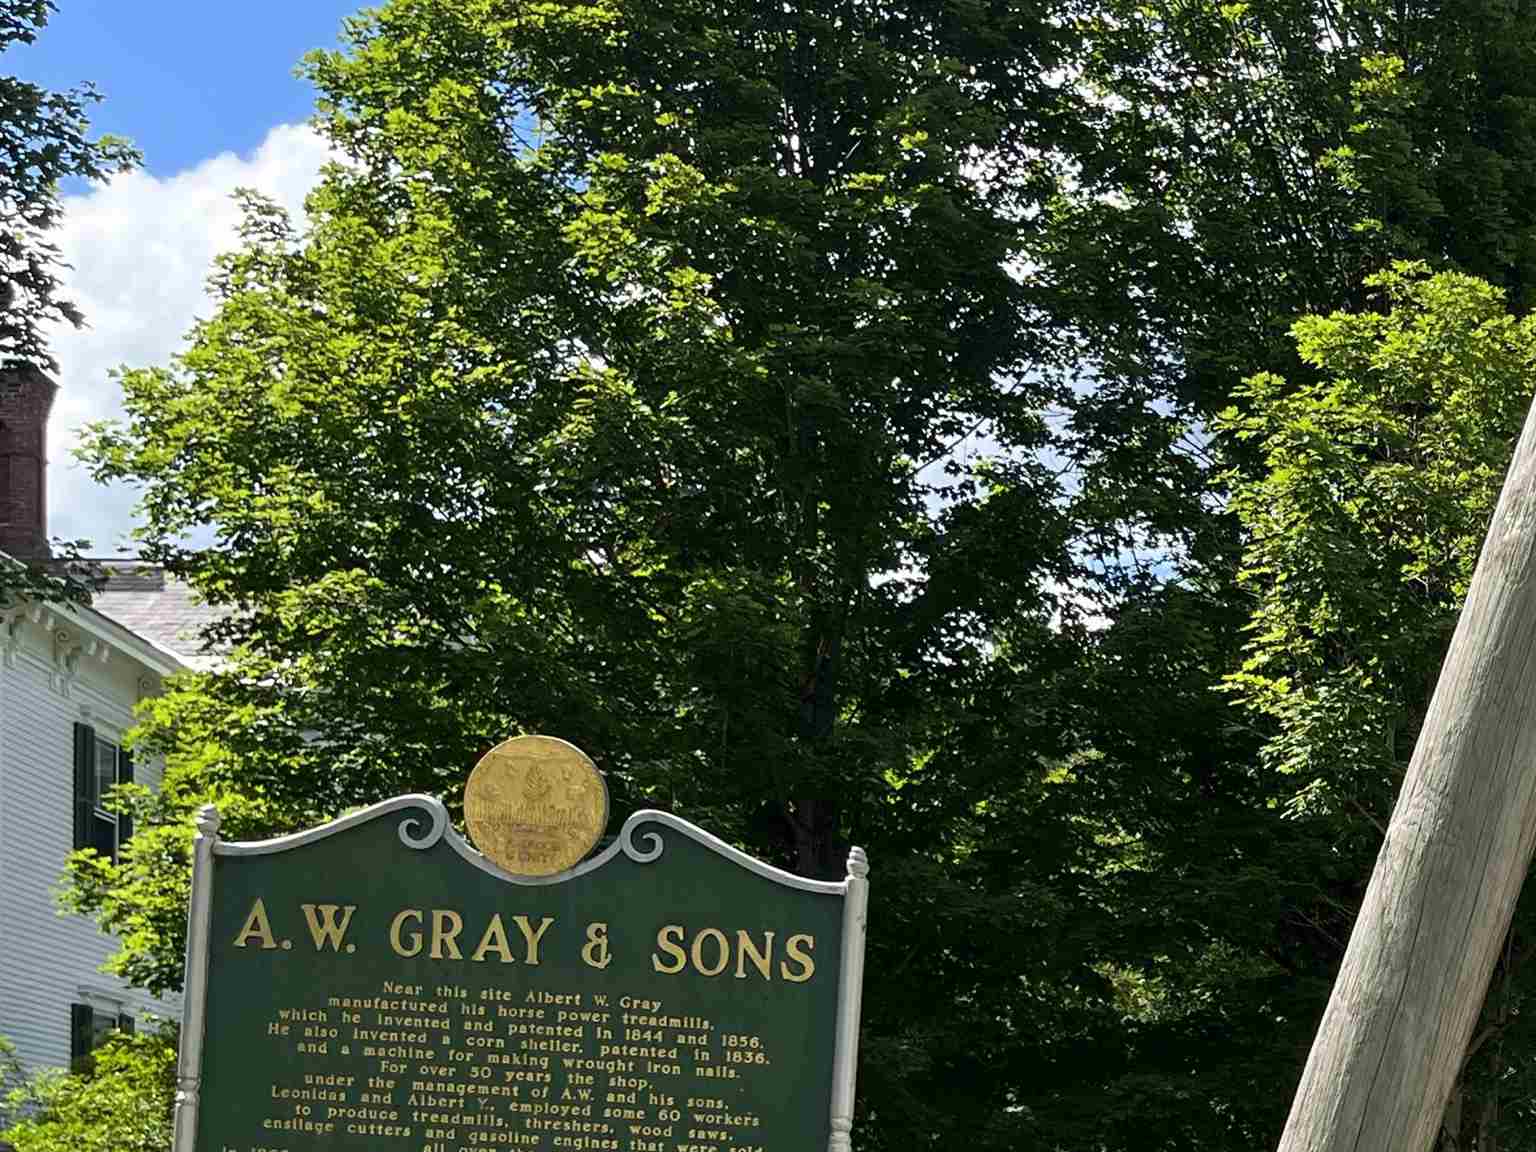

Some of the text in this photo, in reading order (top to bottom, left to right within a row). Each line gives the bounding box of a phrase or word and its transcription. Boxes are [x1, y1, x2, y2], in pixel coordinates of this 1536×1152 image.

[390, 908, 555, 966] GRAY
[581, 921, 613, 970] &
[651, 924, 816, 982] SONS
[328, 996, 448, 1013] manufactured
[461, 1002, 485, 1015] his
[497, 1004, 544, 1019] horse
[557, 1010, 610, 1023] power
[383, 980, 423, 995] Near
[436, 985, 467, 998] this
[479, 987, 511, 1001] site
[524, 989, 580, 1006] Albert
[619, 995, 663, 1011] Gray
[267, 1021, 289, 1035] He
[304, 1025, 338, 1038] also
[352, 1027, 427, 1043] invented
[441, 1034, 450, 1045] a
[465, 1036, 504, 1048] corn
[600, 1044, 677, 1059] patented
[694, 1048, 709, 1061] in
[278, 1007, 327, 1022] which
[342, 1010, 360, 1023] he
[377, 1013, 450, 1030] invented
[463, 1019, 493, 1032] and
[508, 1023, 583, 1037] patented
[596, 1026, 612, 1040] in
[625, 1028, 662, 1042] 1844
[676, 1033, 707, 1045] and
[297, 1041, 327, 1054] and
[340, 1045, 350, 1055] a
[363, 1045, 434, 1059] machine
[448, 1048, 474, 1062] for
[487, 1052, 549, 1068] making
[562, 1058, 634, 1072] wrought
[647, 1060, 680, 1075] iron
[380, 1060, 407, 1074] For
[419, 1064, 456, 1077] over
[469, 1066, 491, 1078] 50
[505, 1070, 551, 1083] years
[567, 1072, 594, 1085] the
[271, 1084, 345, 1101] Leonidas
[360, 1091, 391, 1104] and
[407, 1093, 464, 1108] Albert
[508, 1101, 591, 1116] employed
[603, 1107, 645, 1119] some
[658, 1108, 680, 1121] 60
[693, 1112, 759, 1127] workers
[304, 1073, 354, 1087] under
[367, 1075, 395, 1089] the
[412, 1080, 519, 1096] management
[530, 1085, 549, 1098] of
[605, 1091, 635, 1104] and
[648, 1092, 674, 1106] his
[263, 1117, 334, 1133] ensilage
[347, 1123, 410, 1137] cutters
[425, 1128, 455, 1139] and
[468, 1130, 539, 1144] gasoline
[552, 1135, 618, 1149] engines
[629, 1138, 664, 1152] that
[295, 1103, 311, 1115] to
[327, 1107, 398, 1120] produce
[628, 1125, 672, 1137] wood
